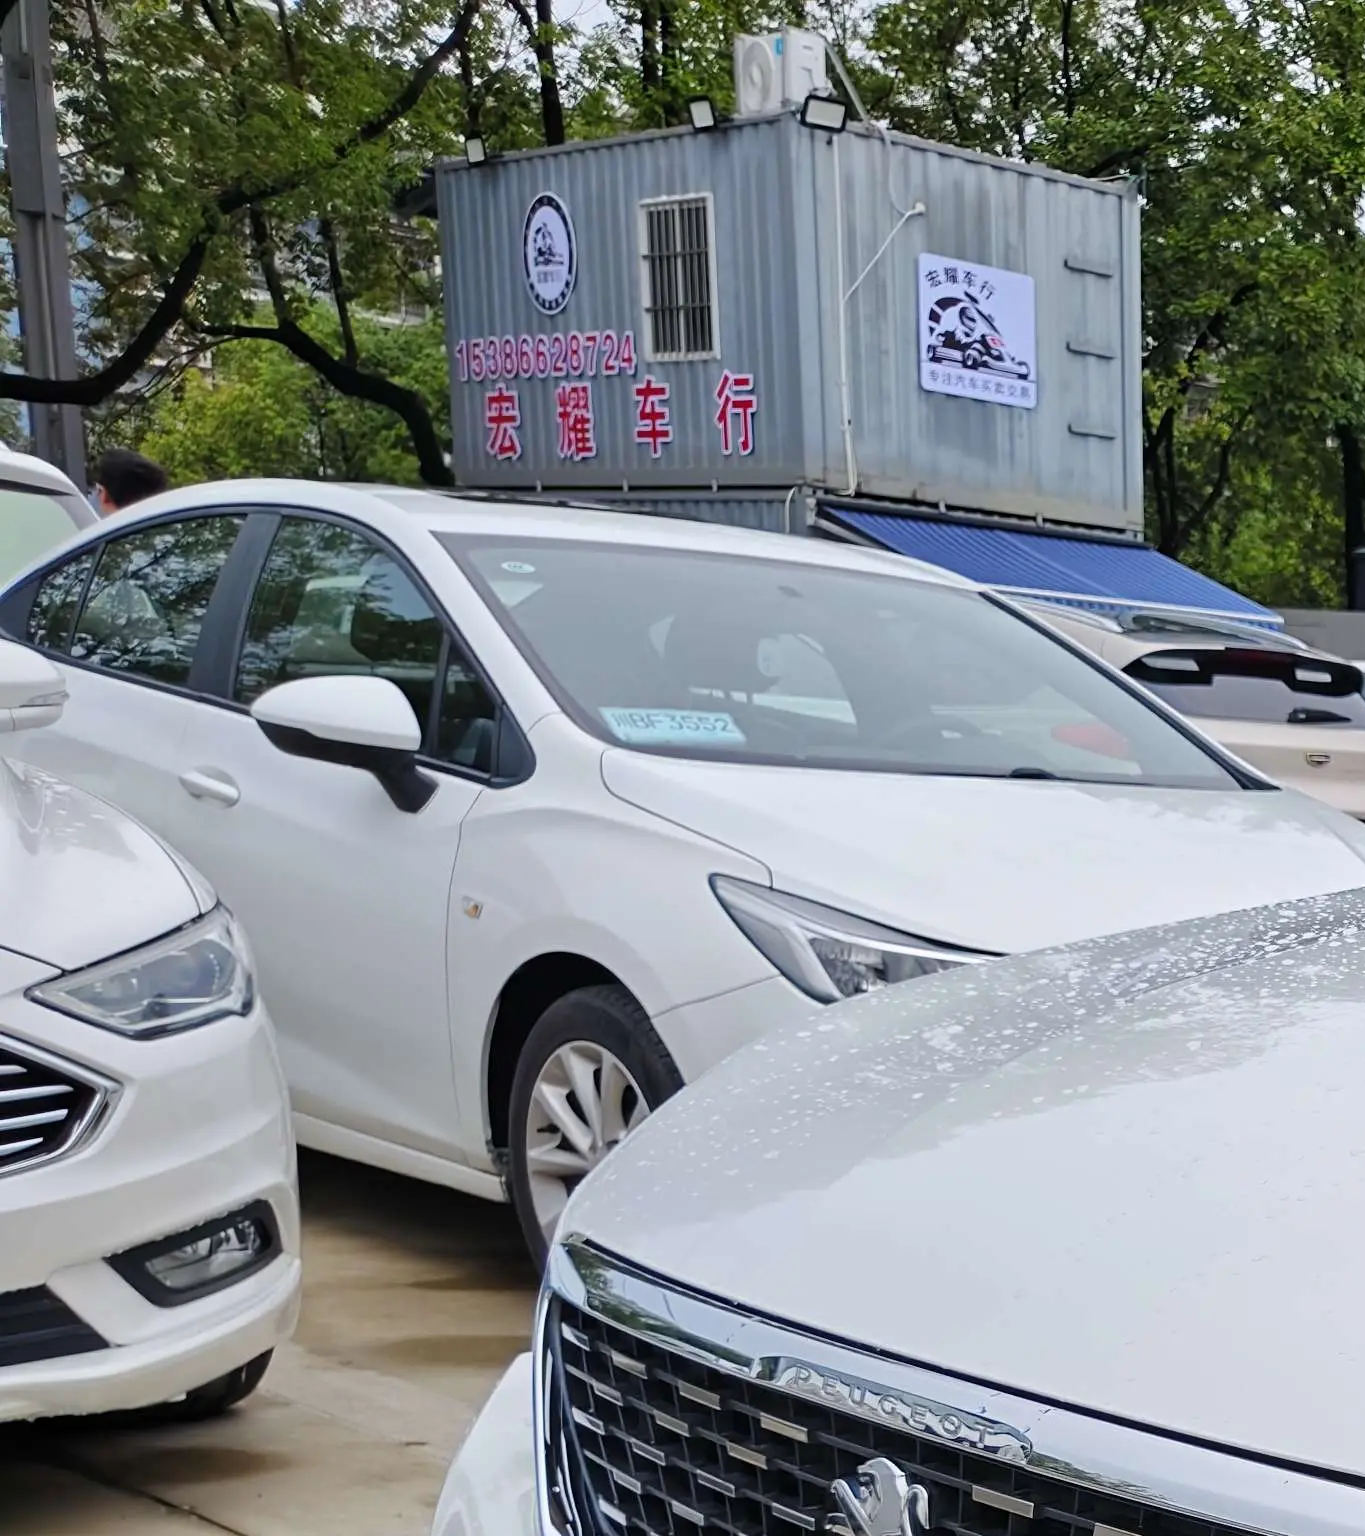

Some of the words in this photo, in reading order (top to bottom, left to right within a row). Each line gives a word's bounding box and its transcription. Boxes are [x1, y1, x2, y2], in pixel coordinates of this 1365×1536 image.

[456, 330, 638, 382] 15386628724
[485, 369, 758, 460] 宏耀车行
[794, 1364, 995, 1449] PEUGEOT
